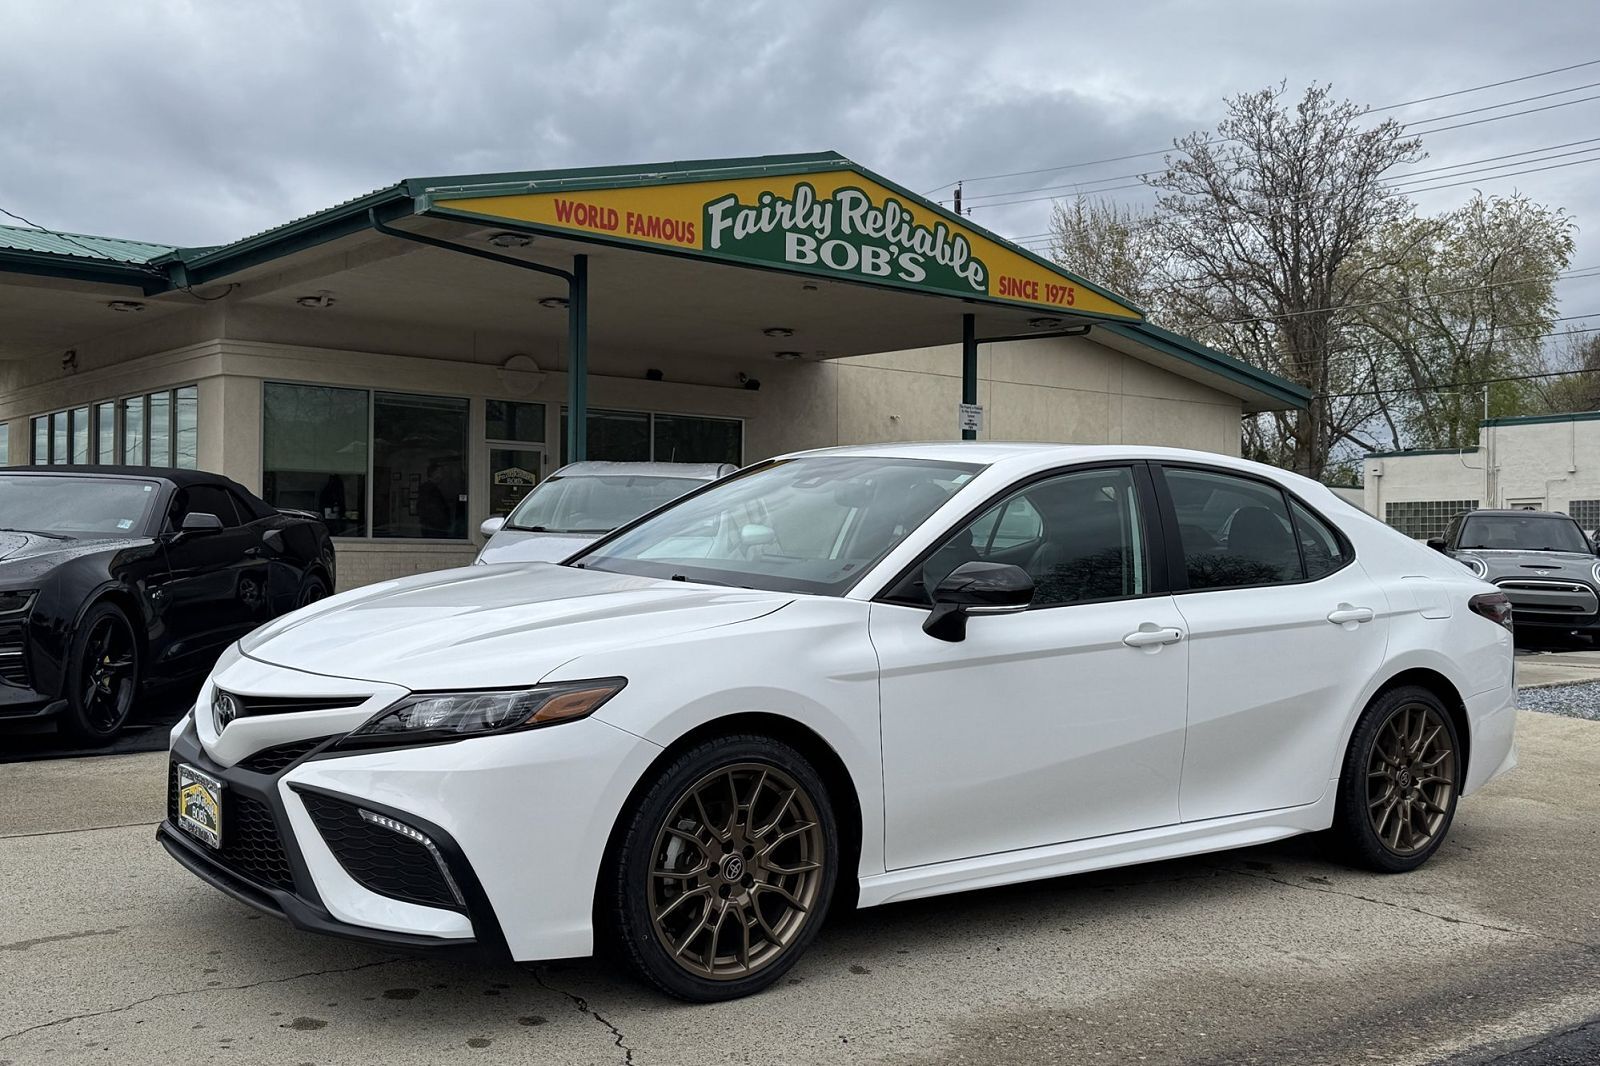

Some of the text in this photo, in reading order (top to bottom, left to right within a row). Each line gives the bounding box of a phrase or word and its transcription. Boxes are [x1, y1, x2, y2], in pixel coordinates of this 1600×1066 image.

[554, 199, 695, 244] WORLD FAMOUS
[708, 186, 986, 291] Fairly Reliable
[785, 232, 927, 283] BOB'S
[999, 275, 1075, 306] SINCE 1975
